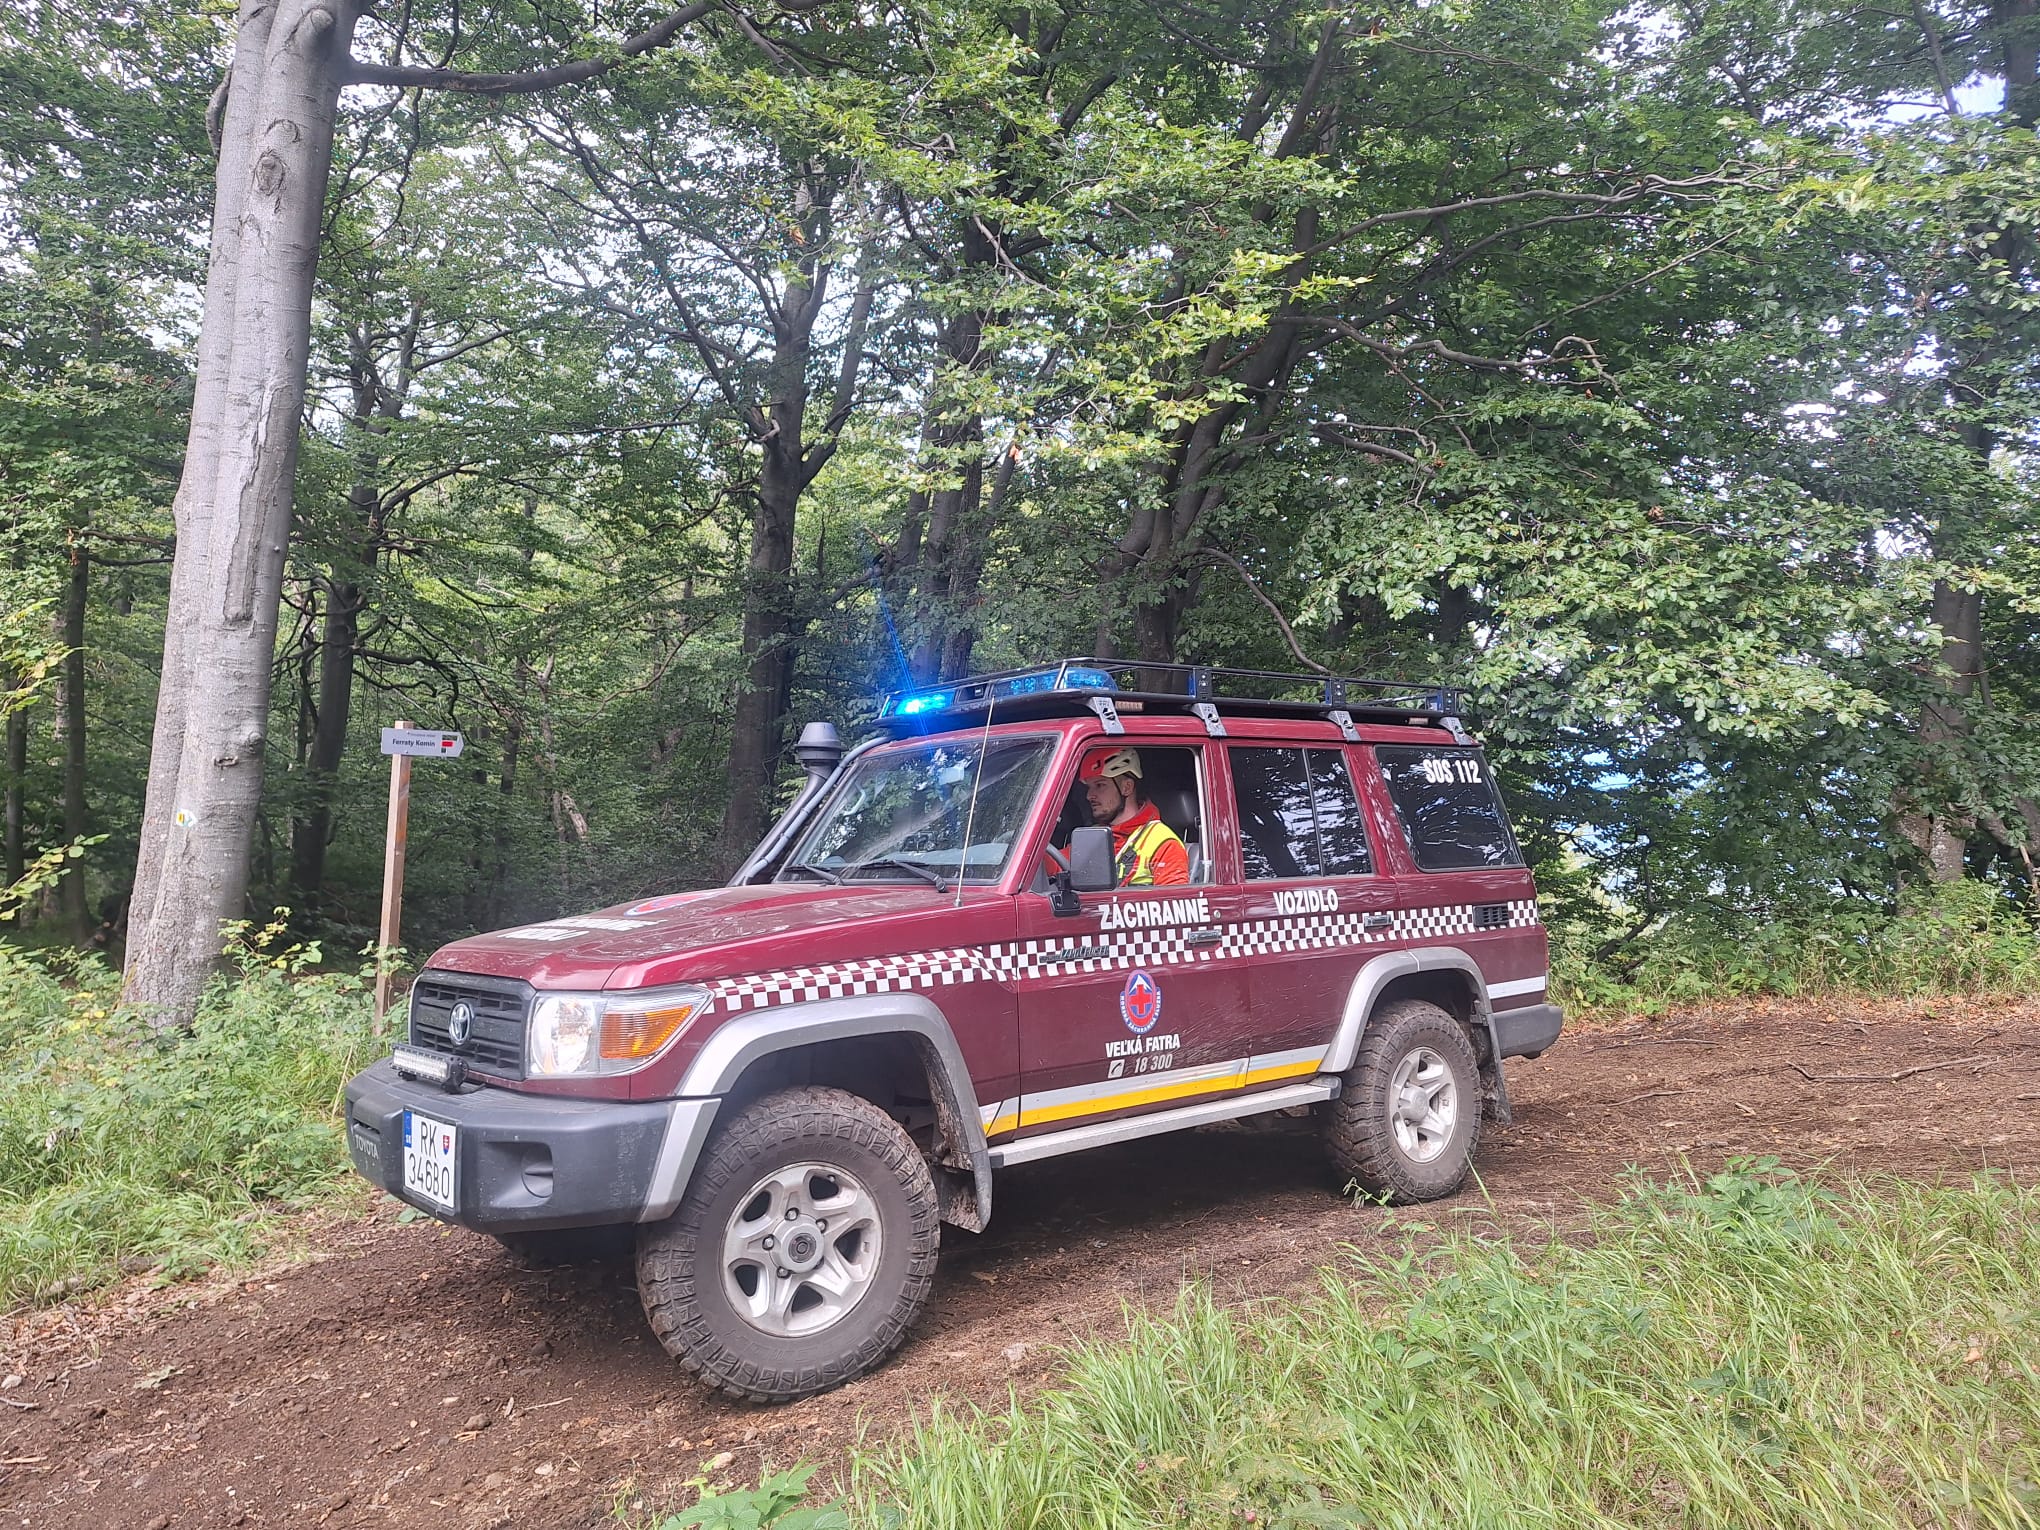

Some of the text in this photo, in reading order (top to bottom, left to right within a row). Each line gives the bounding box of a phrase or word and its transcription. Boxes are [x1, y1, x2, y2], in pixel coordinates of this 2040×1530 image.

[1422, 759, 1482, 784] SOS 112
[1098, 888, 1339, 930] ZÁCHRANNÉ VOZIDLO
[1105, 1033, 1180, 1058] VEĽKÁ FATRA
[1134, 1053, 1173, 1074] 18 300
[354, 1134, 379, 1160] TOYOTA
[420, 1121, 437, 1158] RK
